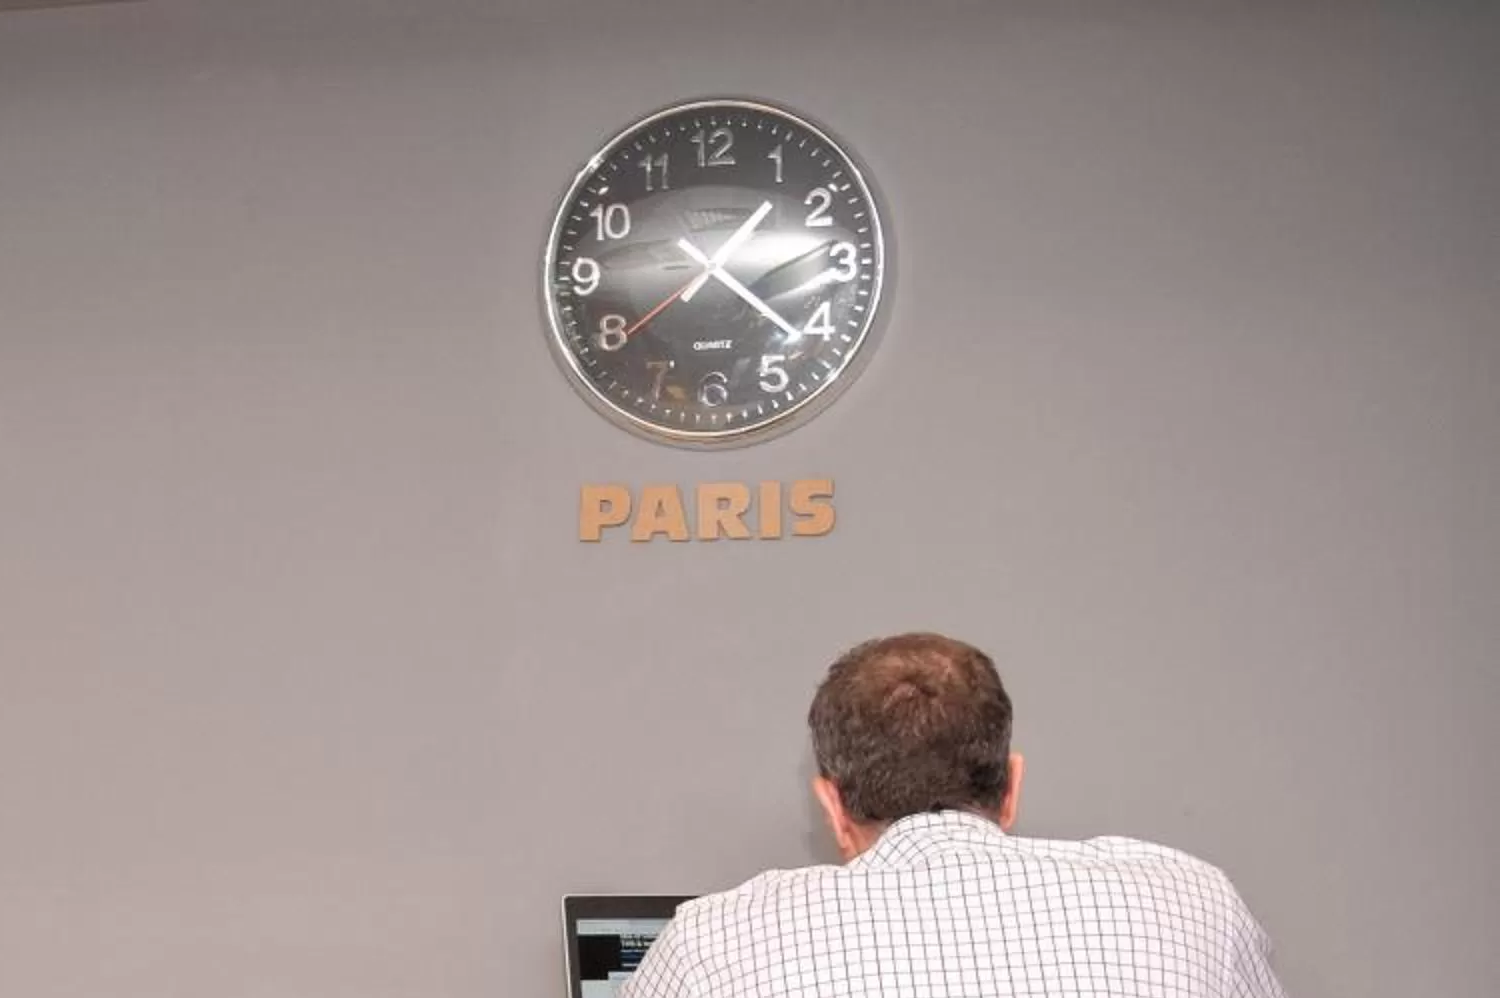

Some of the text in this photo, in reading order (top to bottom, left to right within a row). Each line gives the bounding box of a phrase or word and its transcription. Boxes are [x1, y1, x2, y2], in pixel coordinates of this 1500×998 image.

[690, 127, 737, 167] 12
[767, 143, 785, 184] 1
[638, 152, 671, 192] 11
[589, 203, 632, 242] 10
[803, 187, 834, 228] 2
[571, 256, 602, 296] 9
[828, 241, 857, 283] 3
[600, 313, 629, 351] 8
[803, 300, 836, 342] 4
[645, 360, 669, 402] 7
[699, 371, 729, 407] 6
[758, 354, 790, 394] 5
[578, 478, 836, 542] PARIS
